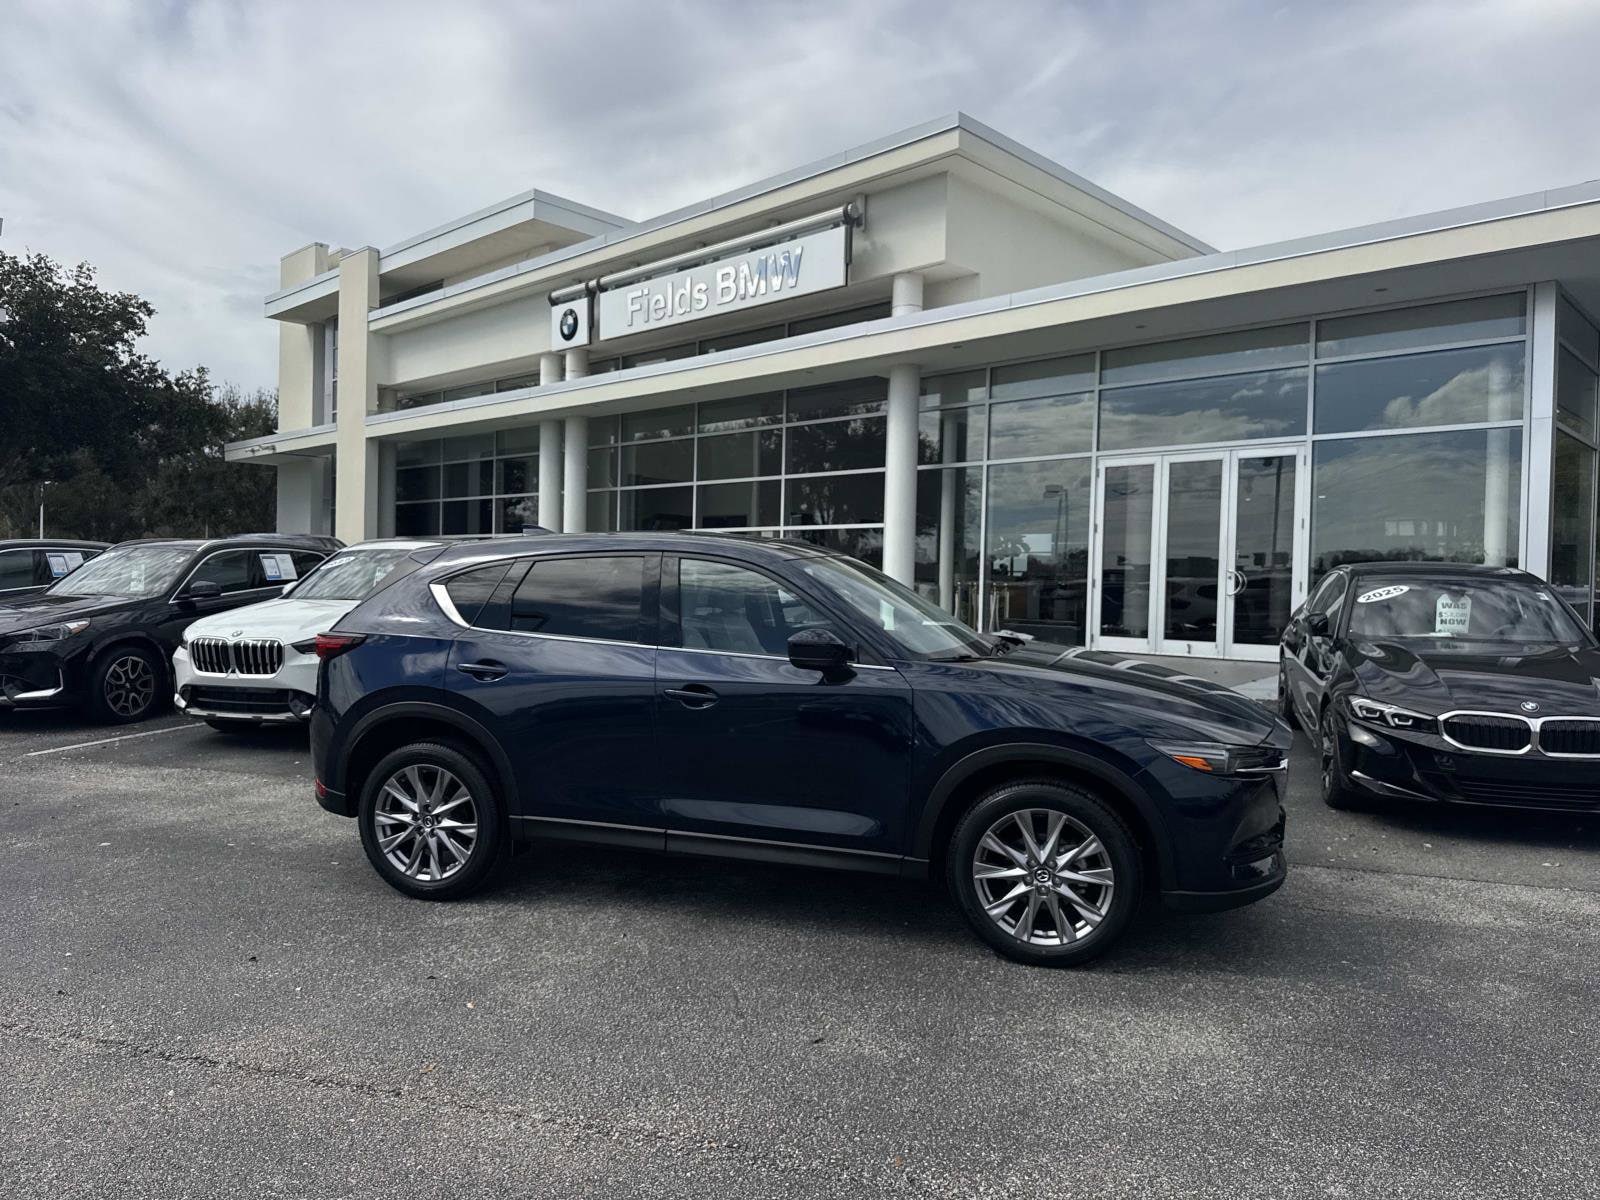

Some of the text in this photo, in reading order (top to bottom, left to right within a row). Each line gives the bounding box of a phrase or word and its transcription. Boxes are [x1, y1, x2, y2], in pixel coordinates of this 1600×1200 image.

[627, 245, 804, 326] Fields BMW
[1362, 586, 1404, 601] 2025
